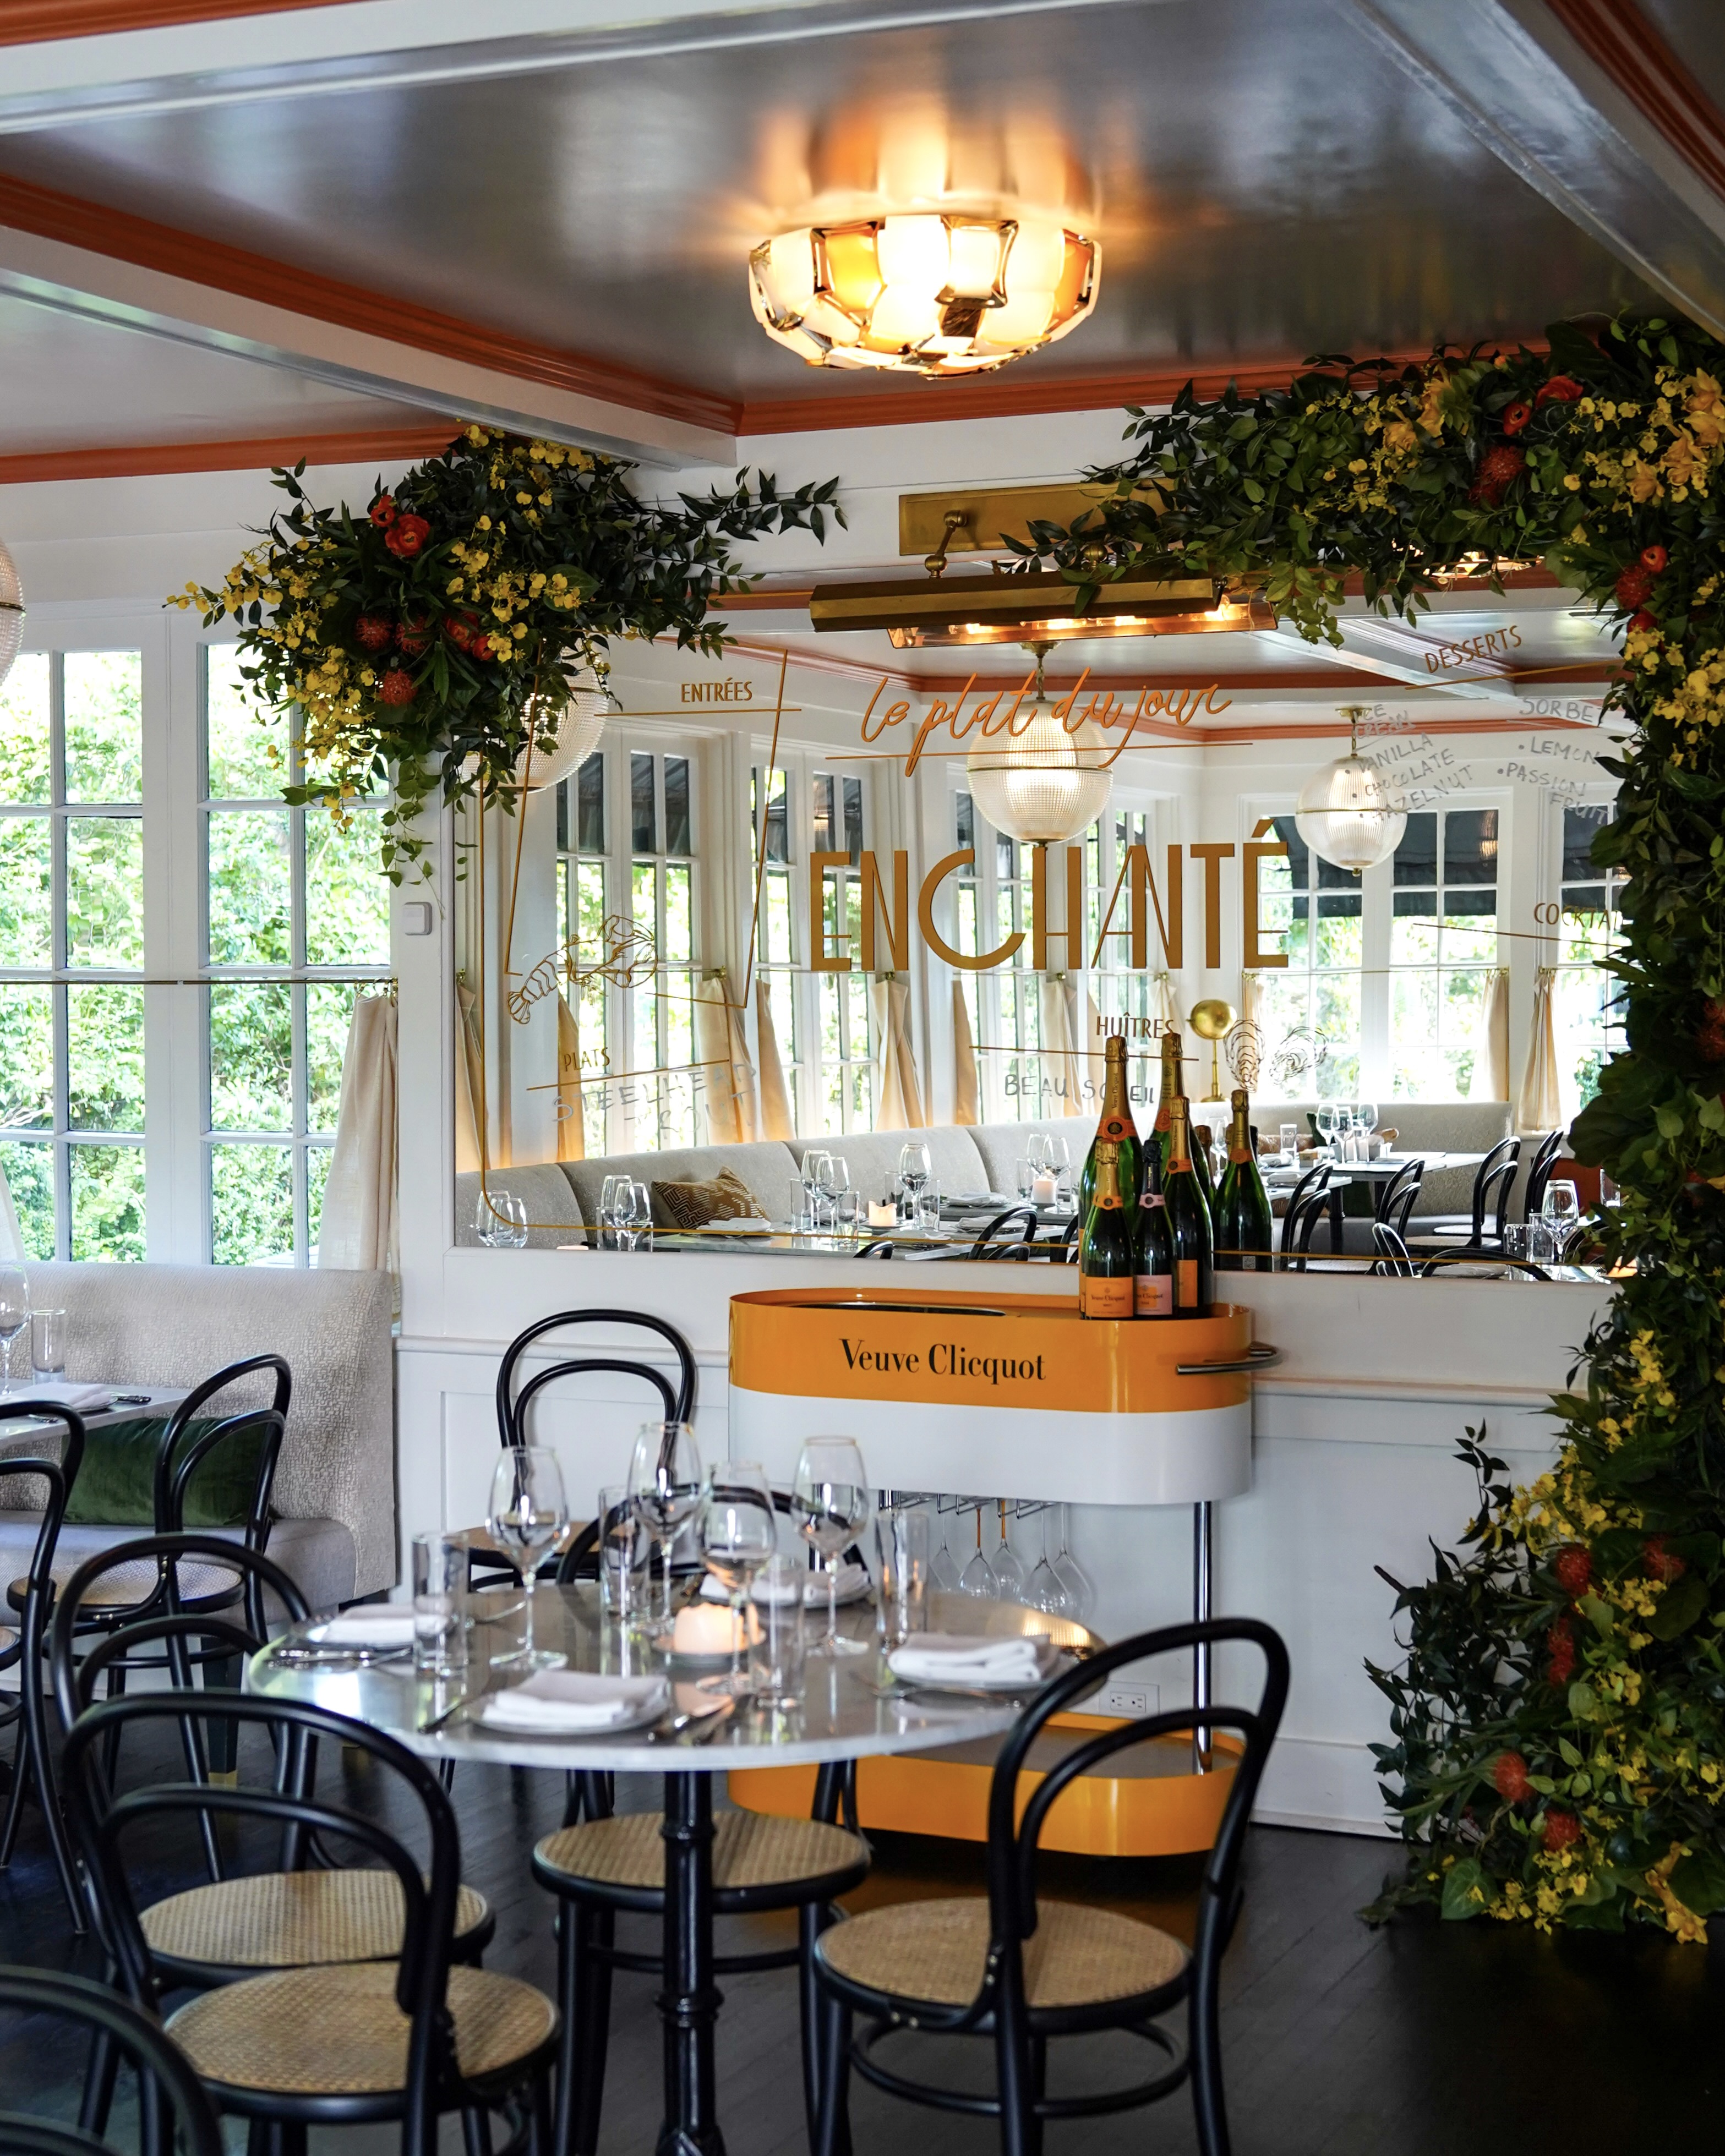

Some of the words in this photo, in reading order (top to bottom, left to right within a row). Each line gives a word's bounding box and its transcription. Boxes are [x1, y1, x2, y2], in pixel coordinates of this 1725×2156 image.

[1424, 625, 1522, 674] DESSERTS
[681, 677, 752, 703] ENTRÉES
[861, 677, 910, 742] le
[905, 672, 1038, 777] plat
[1052, 667, 1123, 734] du
[1098, 683, 1232, 768] jour
[1357, 732, 1433, 773] VANILLA
[1531, 736, 1600, 765] LEMON
[1365, 748, 1455, 796] CHOCOLATE
[1506, 762, 1586, 797] PASSION
[1550, 792, 1609, 824] FRUIT
[810, 819, 1289, 971] ENCHANTÉ
[1533, 902, 1618, 931] COCKTAI
[1096, 1011, 1174, 1039] HUÎTRES
[564, 1047, 610, 1072] PLATS
[1005, 1074, 1069, 1098] BEAU
[838, 1338, 920, 1374] Veuve
[928, 1343, 1046, 1386] Clicquot
